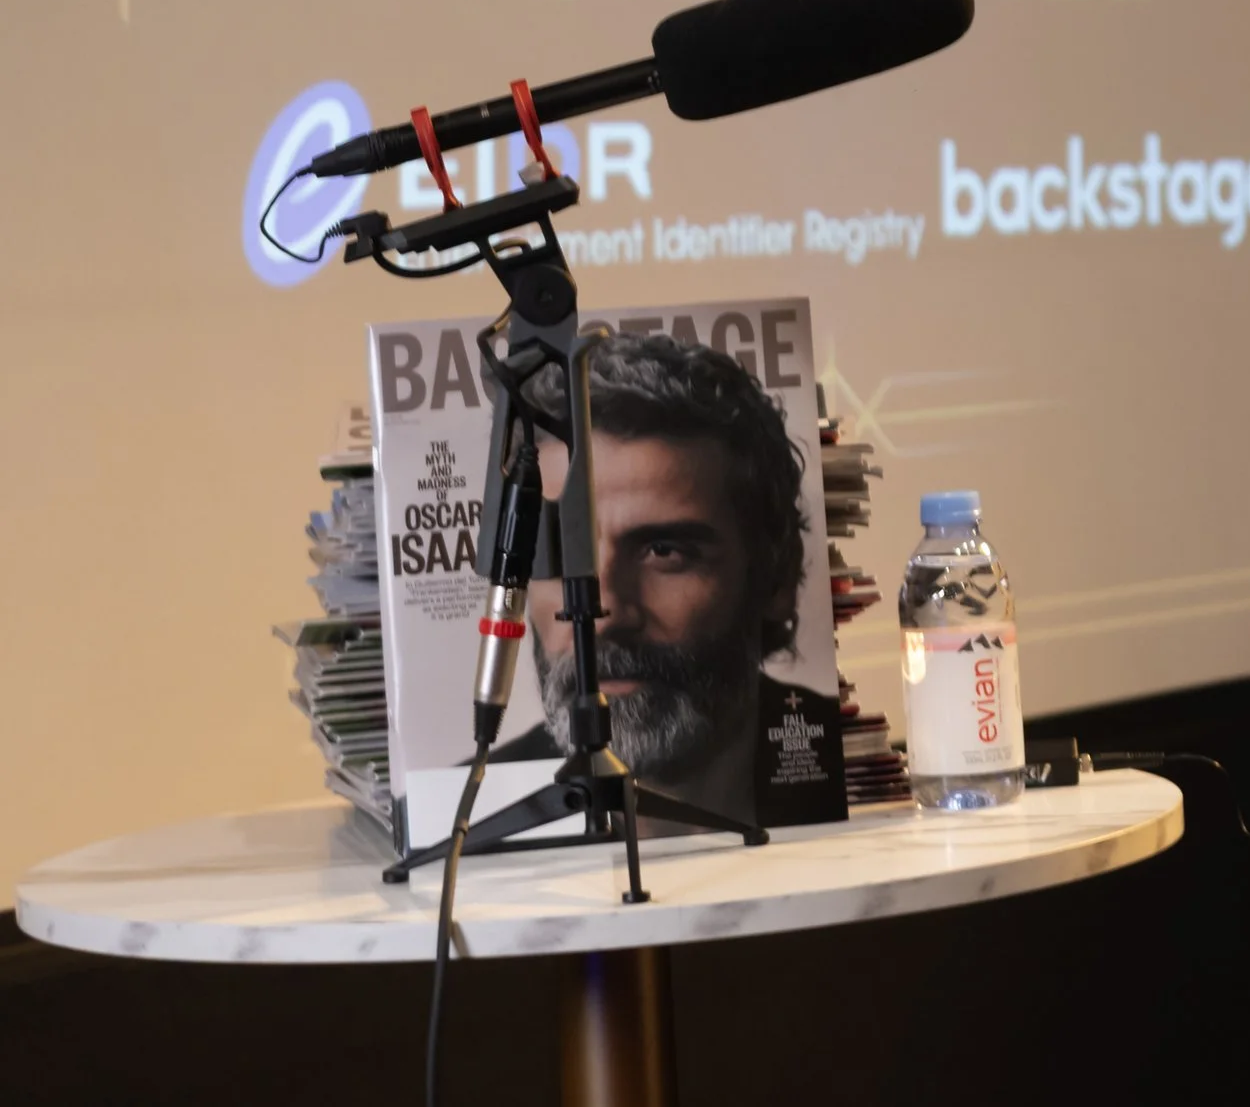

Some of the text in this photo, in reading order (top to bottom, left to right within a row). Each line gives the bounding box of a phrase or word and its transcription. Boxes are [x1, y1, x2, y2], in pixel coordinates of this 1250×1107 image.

[652, 216, 796, 262] Identifier
[803, 208, 926, 267] Registry
[430, 440, 450, 454] THE
[425, 453, 456, 467] MYTH
[431, 465, 452, 479] AND
[417, 476, 467, 492] MADNESS
[404, 500, 483, 532] OSCAR
[391, 529, 479, 577] ISAA
[971, 657, 998, 744] evian
[767, 723, 824, 742] EDUCATION
